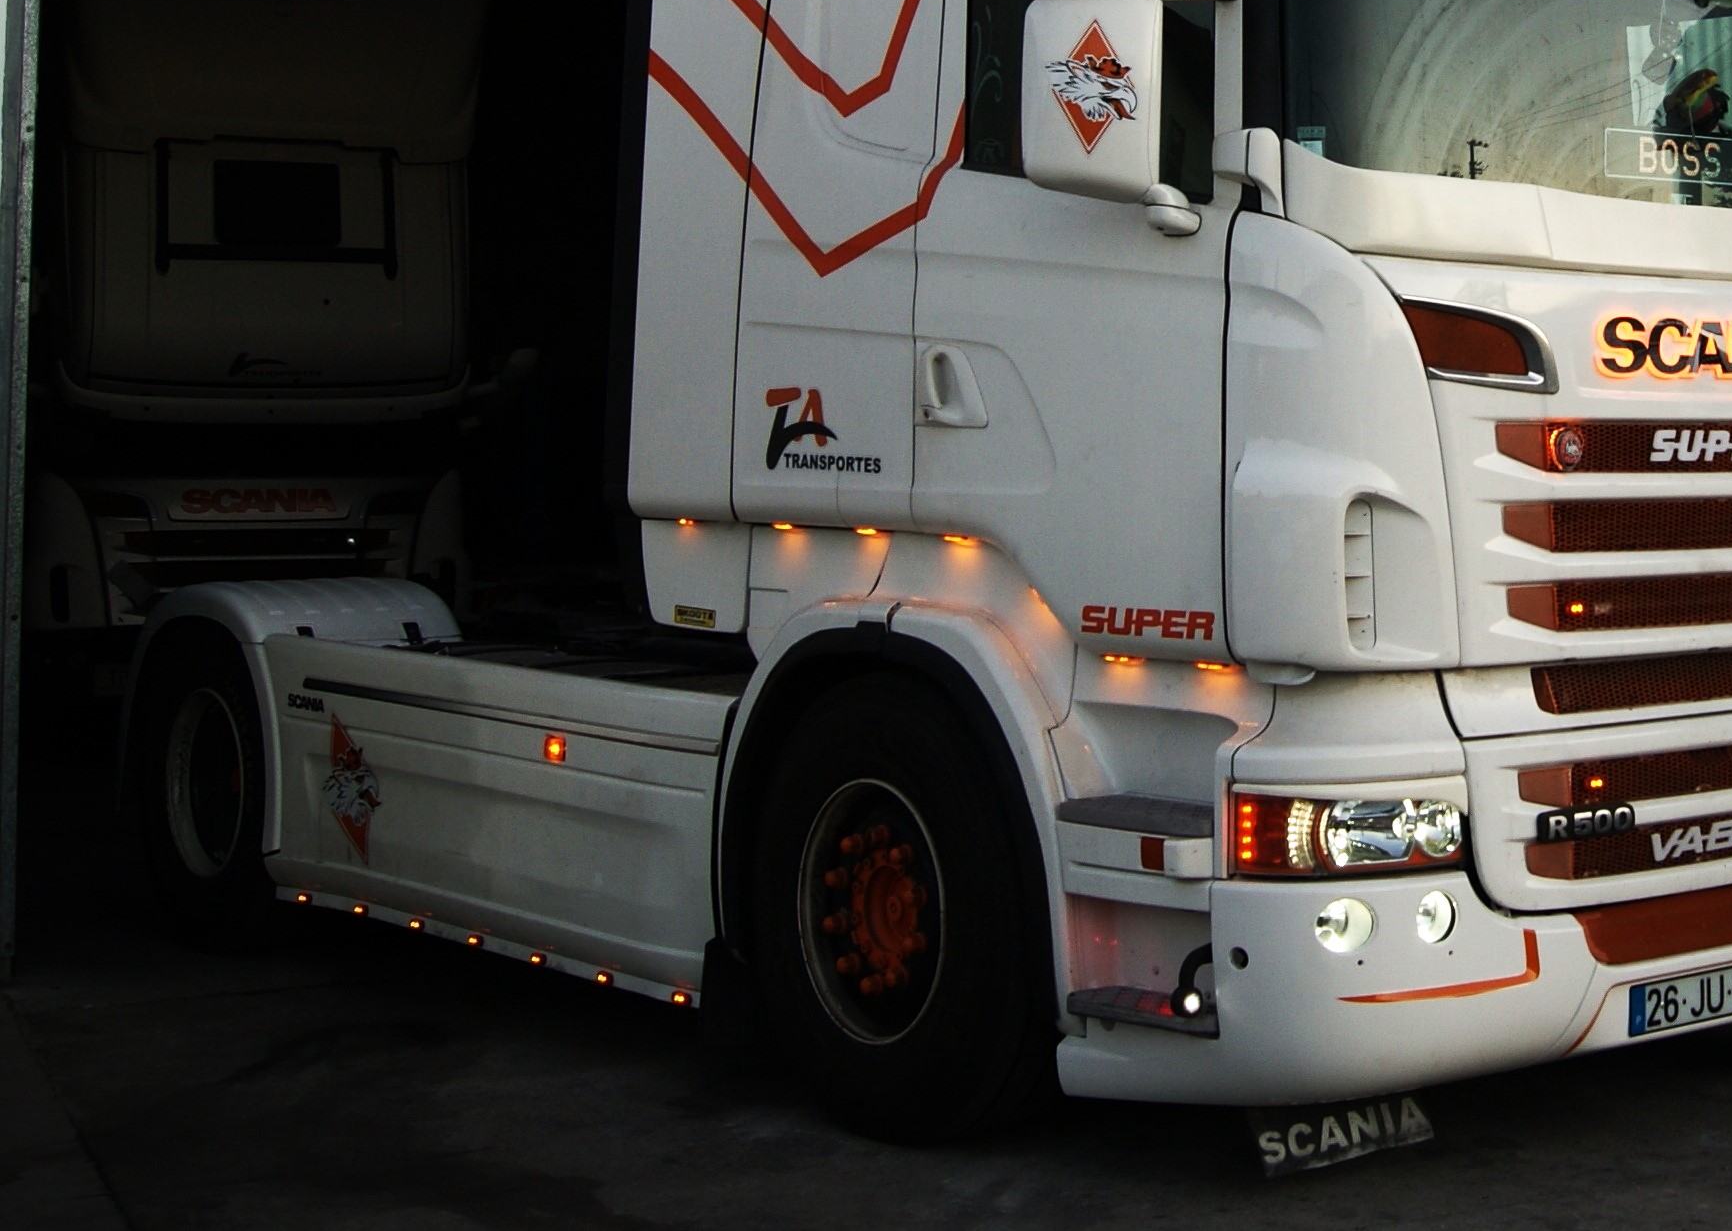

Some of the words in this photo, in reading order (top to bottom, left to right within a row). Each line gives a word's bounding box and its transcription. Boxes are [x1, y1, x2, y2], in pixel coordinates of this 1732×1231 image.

[1638, 135, 1722, 179] BOSS
[783, 452, 882, 474] TRANSPORTES
[180, 487, 338, 514] SCANIA
[1081, 605, 1216, 641] SUPER
[288, 693, 325, 712] SCANIA
[1548, 814, 1568, 841] R
[1573, 806, 1632, 835] 500
[1258, 1096, 1435, 1164] SCANIA
